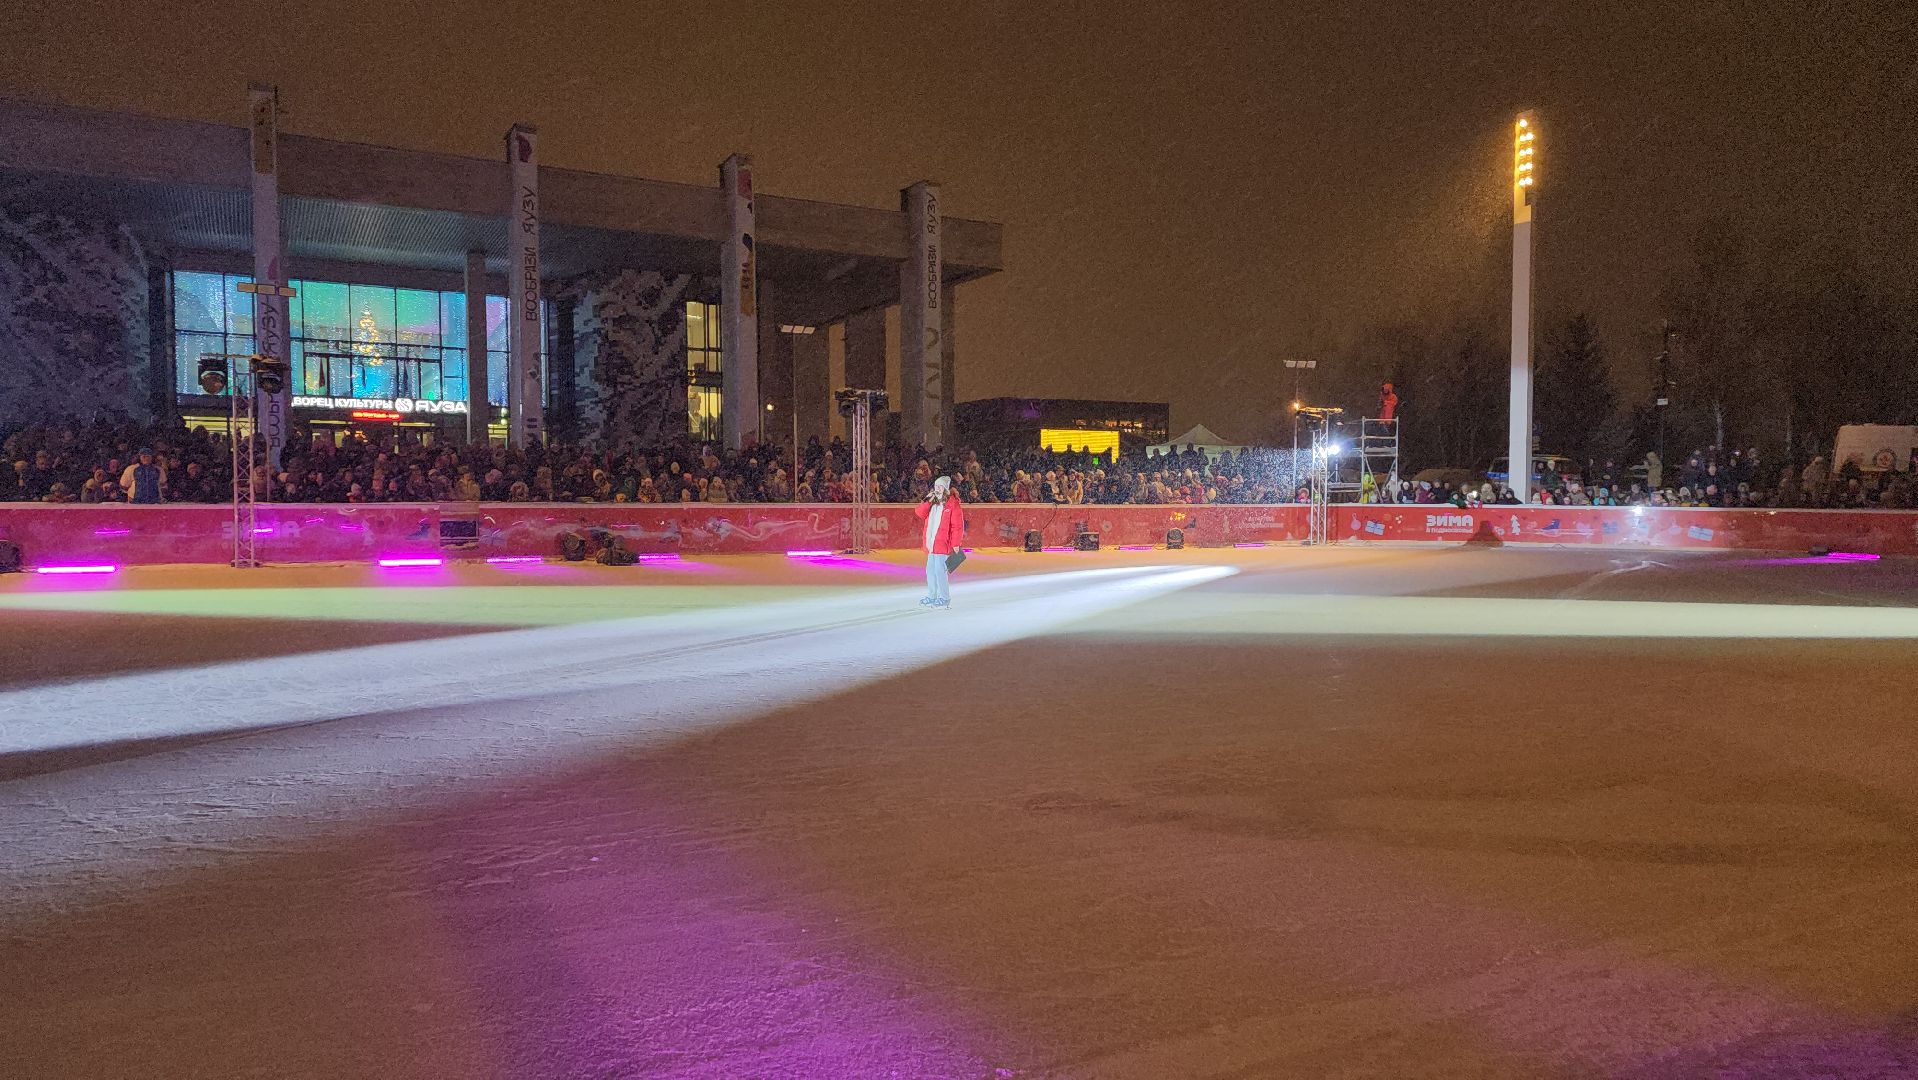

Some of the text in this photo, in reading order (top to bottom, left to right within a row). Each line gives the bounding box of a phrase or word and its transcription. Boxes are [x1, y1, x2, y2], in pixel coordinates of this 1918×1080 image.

[522, 186, 537, 321] ВООБРАЗИ ЯУЗУ
[291, 396, 467, 412] ВОРЕЦ КУЛЬТУРЫ ЯУЗА
[1426, 514, 1473, 527] ЗИМА
